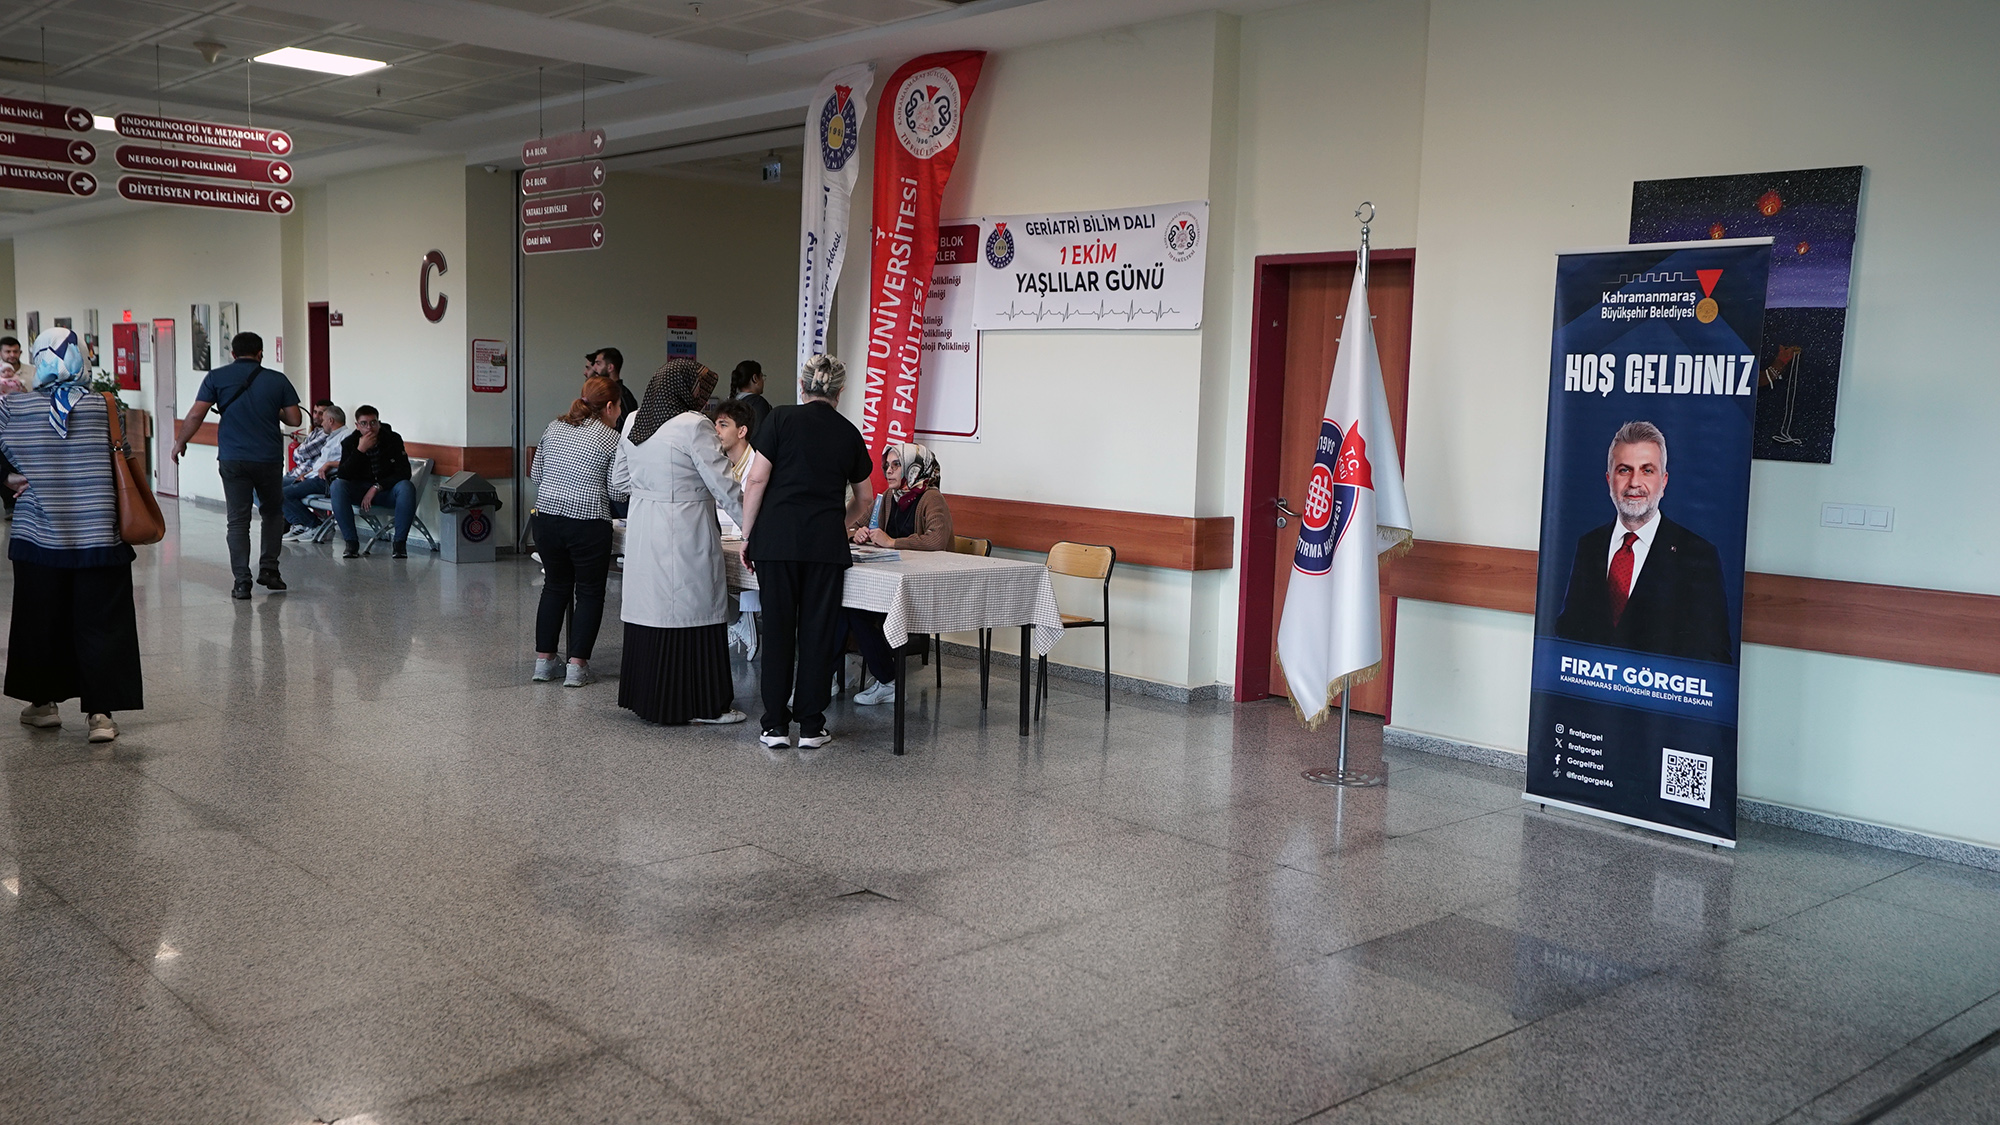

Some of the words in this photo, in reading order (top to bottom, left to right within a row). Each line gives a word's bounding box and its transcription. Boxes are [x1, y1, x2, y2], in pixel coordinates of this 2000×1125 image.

[121, 116, 199, 134] ENDOKRİNOLOJİ
[200, 126, 212, 135] VE
[214, 126, 265, 141] METABOLİK
[121, 126, 184, 142] HASTALIKLAR
[186, 133, 242, 148] POLİKLİNİĞİ
[534, 146, 547, 156] BLOK
[10, 167, 65, 182] ULTRASON
[127, 154, 179, 168] NEFROLOJİ
[181, 158, 237, 173] POLİKLİNİĞİ
[534, 177, 547, 186] BLOK
[128, 181, 191, 199] DİYETİSYEN
[194, 189, 260, 205] POLİKLİNİĞİ
[526, 207, 543, 216] YATAKLI
[544, 204, 568, 215] SERVİSLER
[1025, 216, 1080, 236] GERİATRİ
[1083, 214, 1121, 233] BİLİM
[1124, 213, 1155, 230] DALI
[539, 234, 551, 244] BİNA
[940, 236, 964, 247] BLOK
[826, 231, 842, 271] Adresi
[1060, 247, 1067, 265] 1
[1072, 238, 1117, 265] EKİM
[867, 176, 918, 359] ÜNİVERSİTESİ
[419, 248, 448, 324] C
[1016, 270, 1100, 297] YAŞLILAR
[1105, 262, 1164, 291] GÜNÜ
[1602, 291, 1696, 304] Kahramanmaraş
[1601, 305, 1648, 321] Büyükşehir
[1650, 305, 1695, 321] Belediyesi
[892, 277, 924, 414] FAKÜLTESİ
[937, 342, 970, 353] Polikliniği
[1564, 354, 1616, 398] HOŞ
[1624, 354, 1755, 396] GELDİNİZ
[861, 366, 887, 450] MAM
[1339, 455, 1348, 480] KSÜ
[1345, 446, 1360, 476] T.C.
[1561, 656, 1618, 681] FIRAT
[1622, 667, 1713, 697] GÖRGEL
[1560, 675, 1612, 690] KAHRAMANMARAŞ
[1613, 684, 1650, 697] BÜYÜKŞEHİR
[1651, 690, 1682, 702] BELEDİYE
[1683, 696, 1713, 707] BAŞKANI
[1569, 728, 1603, 741] firatgorgel
[1568, 742, 1603, 756] firatgorgel
[1567, 757, 1604, 771] GorgelFirat
[1566, 771, 1614, 788] @firatgorgel46
